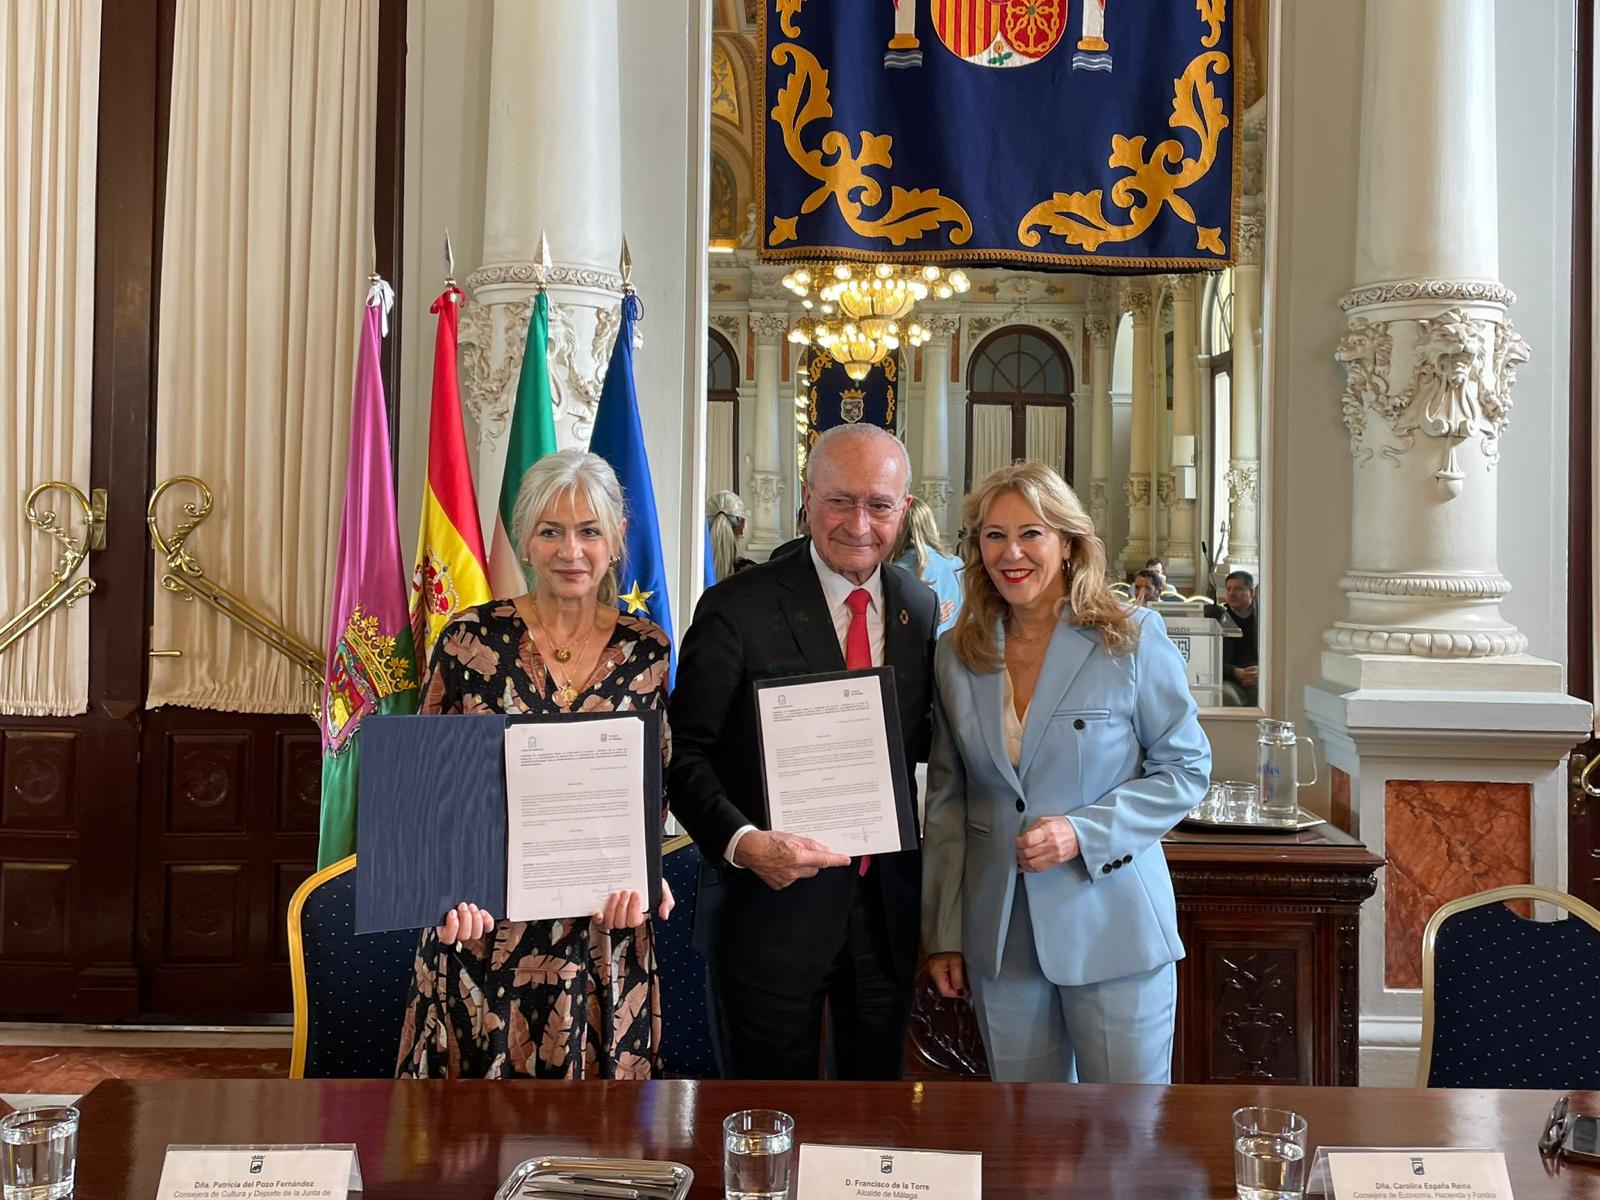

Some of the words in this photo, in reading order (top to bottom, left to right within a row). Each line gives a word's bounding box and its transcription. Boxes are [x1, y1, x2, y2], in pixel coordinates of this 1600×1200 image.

[194, 1181, 210, 1189] Dña.
[242, 1180, 254, 1188] del
[256, 1180, 274, 1188] Pozo
[276, 1180, 314, 1188] Fernández
[854, 1179, 890, 1188] Francisco
[891, 1181, 901, 1189] de
[910, 1182, 930, 1191] Torre
[1375, 1182, 1392, 1190] Dña.
[1393, 1182, 1422, 1190] Carolina
[1423, 1182, 1450, 1190] España
[173, 1190, 209, 1199] Consejera
[210, 1190, 220, 1198] de
[221, 1190, 246, 1198] Cultura
[253, 1189, 281, 1199] Deporte
[282, 1189, 292, 1197] de
[293, 1189, 300, 1197] la
[301, 1189, 321, 1197] Junta
[322, 1189, 332, 1197] de
[856, 1189, 881, 1197] Alcalde
[882, 1190, 892, 1198] de
[893, 1191, 918, 1200] Málaga
[1353, 1191, 1387, 1200] Consejera
[1388, 1191, 1397, 1199] de
[1434, 1191, 1466, 1199] Hacienda
[1472, 1191, 1497, 1199] Fondos
